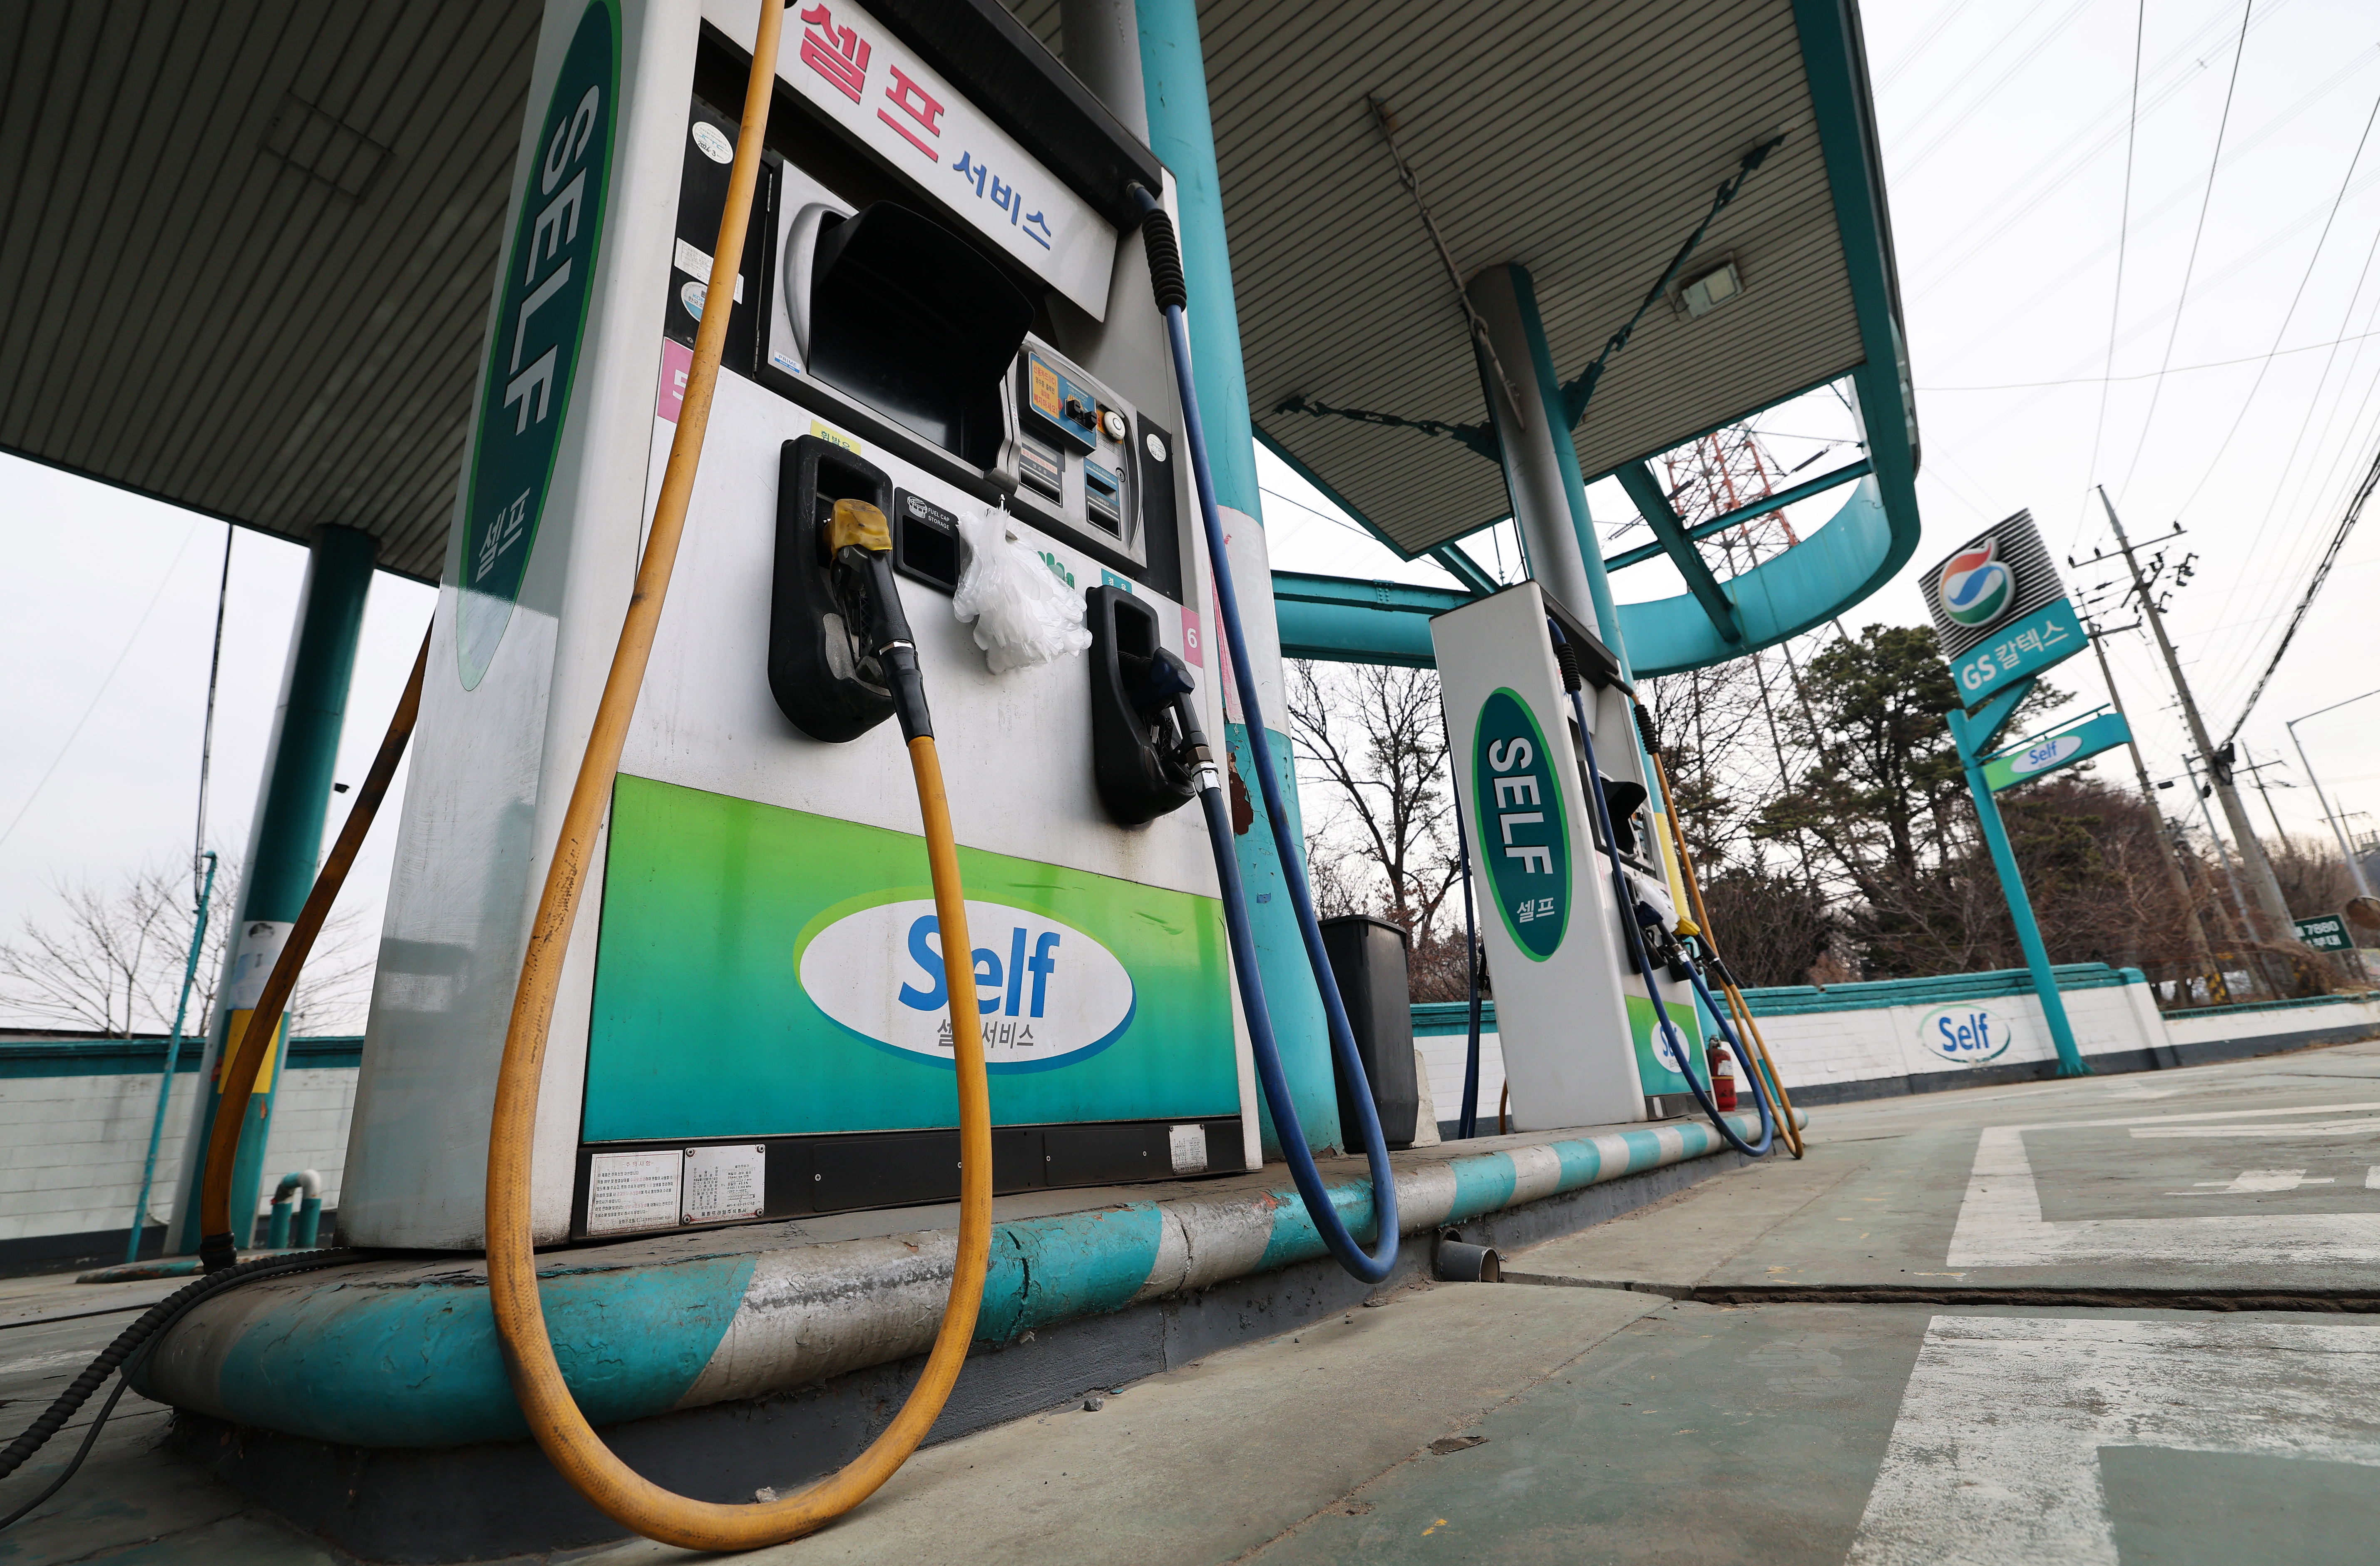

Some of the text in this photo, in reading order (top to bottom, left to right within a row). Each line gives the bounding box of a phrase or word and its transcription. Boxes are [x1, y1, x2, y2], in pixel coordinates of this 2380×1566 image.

[800, 2, 1053, 251] 셀프 서비스
[504, 85, 599, 436] SELF
[779, 354, 797, 367] PRIME
[1033, 365, 1056, 386] 신용카드(IC)
[1036, 376, 1044, 388] 영수증
[1033, 393, 1058, 415] 빼지마세요!
[928, 507, 939, 518] FUEL
[928, 515, 949, 530] STORAGE
[476, 487, 531, 583] 셀프
[1187, 628, 1197, 648] 6
[1962, 620, 2069, 690] GS 칼텍스
[2030, 741, 2057, 764] Self
[1489, 735, 1554, 875] SELF
[1516, 897, 1555, 924] 셀프
[898, 915, 1061, 1018] Self
[983, 1021, 1034, 1050] 서비스
[1939, 1013, 1989, 1052] Self
